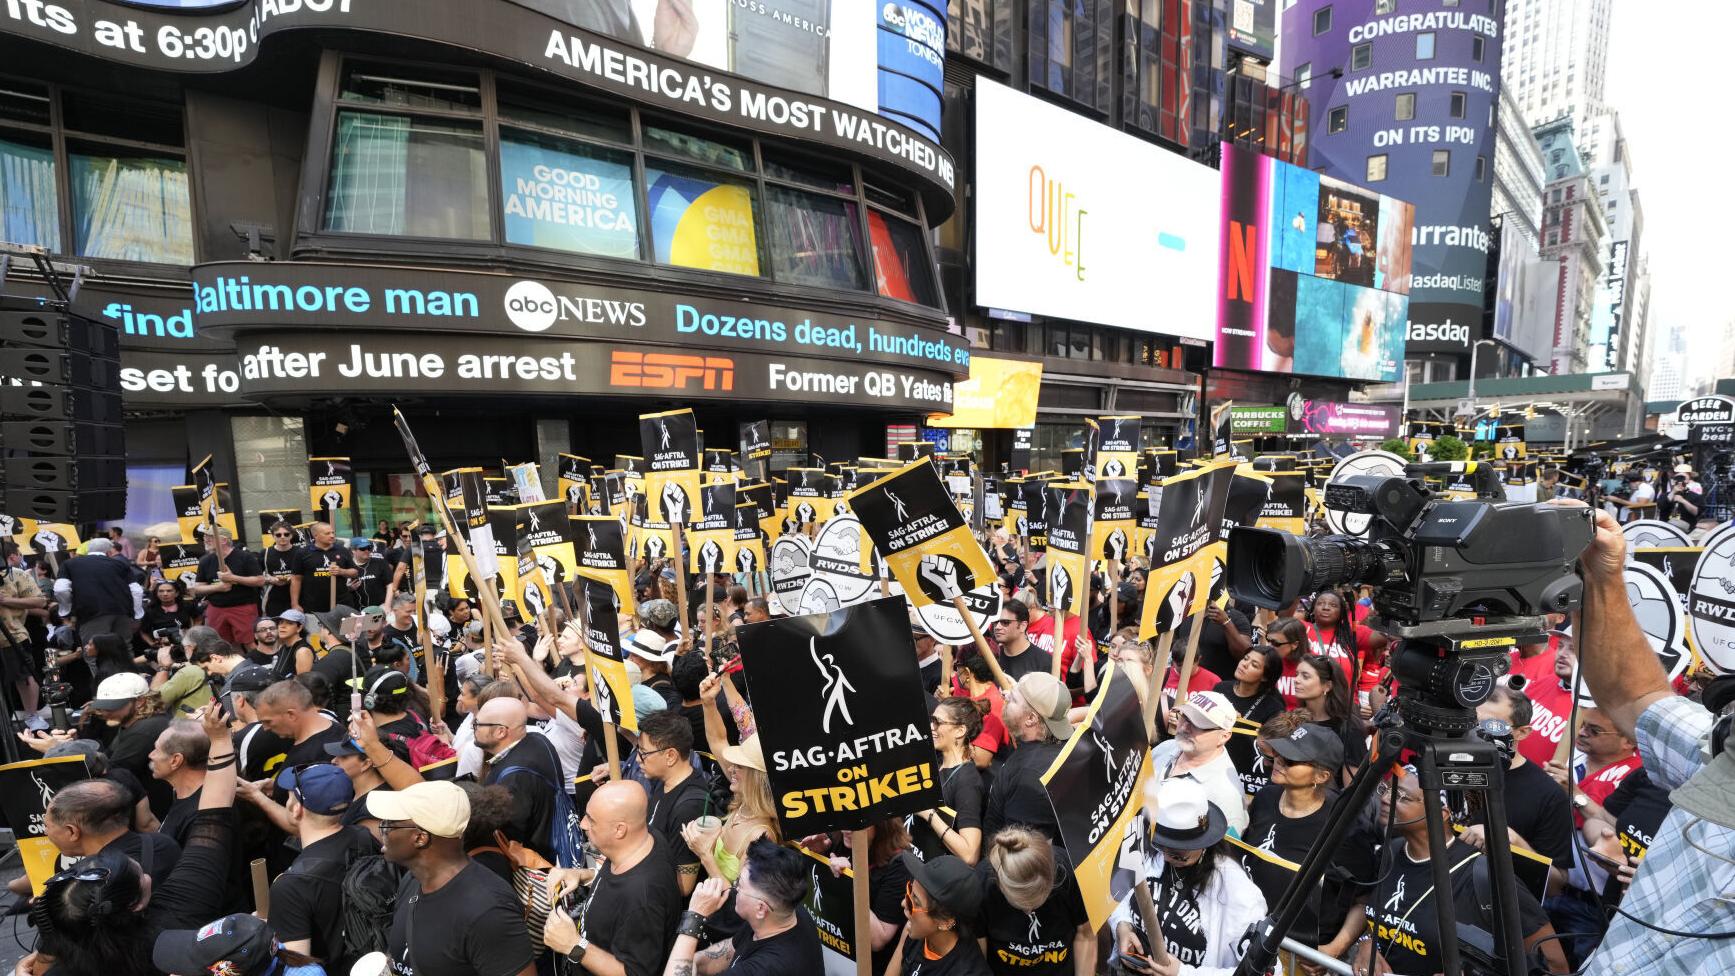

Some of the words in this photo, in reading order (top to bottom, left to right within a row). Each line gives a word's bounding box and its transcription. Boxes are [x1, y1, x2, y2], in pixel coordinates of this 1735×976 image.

[772, 9, 832, 39] AMERICA
[1348, 11, 1497, 43] CONGRATULATES
[95, 19, 146, 52] at
[157, 25, 247, 62] 6:30p
[1346, 68, 1468, 96] WARRANTEE
[1471, 70, 1493, 92] INC.
[545, 30, 731, 111] AMERICA'S
[741, 89, 826, 132] MOST
[832, 110, 935, 172] WATCHED
[1373, 130, 1403, 147] ON
[1409, 127, 1440, 144] ITS
[1445, 127, 1474, 145] IPO!
[533, 164, 600, 190] GOOD
[516, 177, 618, 209] MORNING
[505, 194, 635, 233] AMERICA
[704, 205, 748, 227] GMA
[706, 225, 751, 244] GMA
[709, 244, 754, 263] GMA
[384, 286, 479, 317] man
[558, 295, 647, 326] NEWS
[676, 304, 786, 342] Dozens
[795, 317, 863, 352] dead,
[869, 328, 951, 362] hundreds
[120, 365, 193, 392] set
[202, 364, 241, 393] fo
[243, 345, 325, 381] after
[338, 344, 441, 385] June
[457, 351, 576, 382] arrest
[610, 350, 734, 391] ESPN
[768, 363, 858, 394] Former
[864, 372, 896, 397] QB
[900, 375, 942, 402] Yates
[1231, 411, 1285, 419] TARBUCKS
[1681, 411, 1729, 421] GARDEN
[1691, 399, 1722, 410] BEER
[1234, 420, 1271, 428] COFFEE
[1701, 433, 1733, 441] best
[888, 537, 904, 551] ON
[903, 519, 950, 546] STRIKE!
[815, 559, 860, 575] RWDS
[776, 577, 806, 591] RWDS
[837, 764, 869, 782] ON
[781, 762, 935, 820] STRIKE!
[1088, 821, 1108, 845] ON
[997, 948, 1068, 969] STRONG
